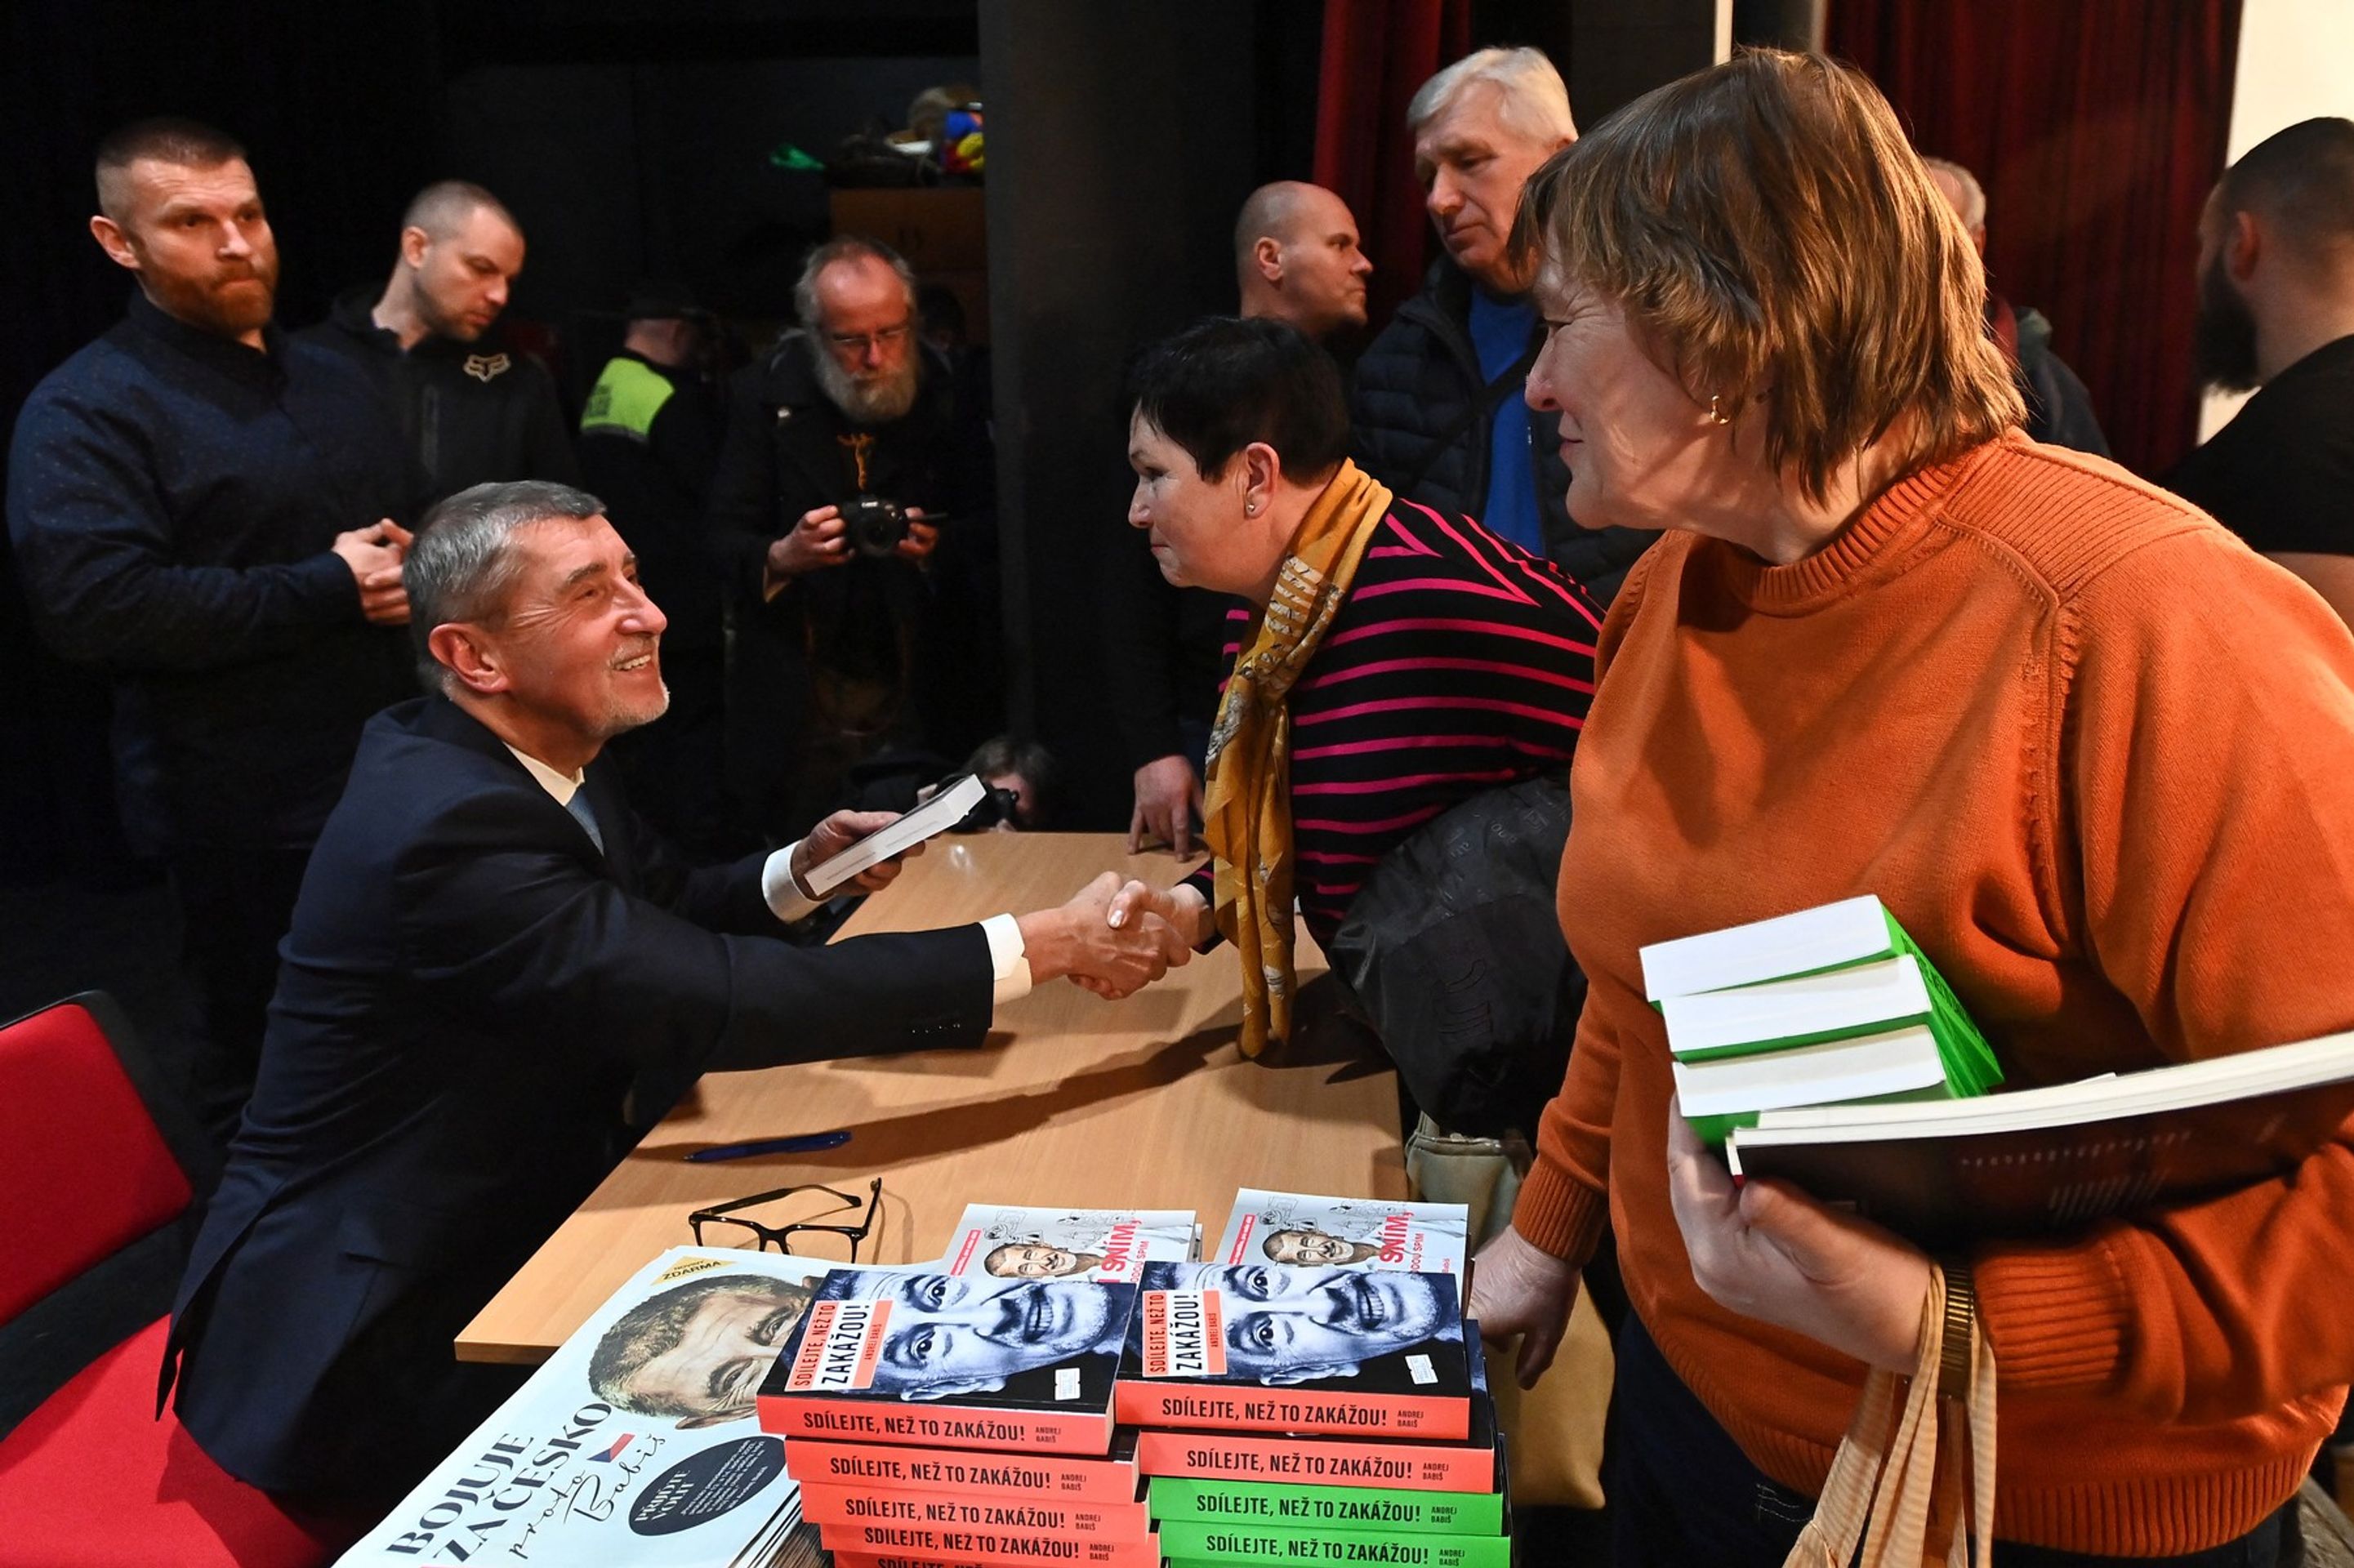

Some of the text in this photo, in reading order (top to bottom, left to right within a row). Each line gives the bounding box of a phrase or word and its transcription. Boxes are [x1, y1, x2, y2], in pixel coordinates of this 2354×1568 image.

[1101, 1218, 1142, 1272] SNÍM,
[1379, 1211, 1415, 1263] SNÍM,
[663, 1261, 721, 1280] ZDARMA
[794, 1305, 836, 1386] SDÍLEJTE, NEŽ TO
[821, 1305, 869, 1384] ZAKÁŽOU!
[1147, 1294, 1166, 1372] SDÍLEJTE, NEŽ TO
[1170, 1294, 1202, 1370] ZAKÁŽOU!
[804, 1411, 1024, 1441] SDÍLEJTE, NEŽ TO ZAKÁŽOU!
[1163, 1396, 1386, 1425] SDÍLEJTE, NEŽ TO ZAKÁŽOU!
[433, 1403, 612, 1562] ZA ČESKO
[564, 1433, 666, 1524] Babiš
[831, 1456, 1050, 1488] SDÍLEJTE, NEŽ TO ZAKÁŽOU!
[1188, 1449, 1411, 1478] SDÍLEJTE, NEŽ TO ZAKÁŽOU!
[386, 1433, 533, 1554] BOJUJE
[652, 1482, 694, 1520] VOLIT
[1197, 1493, 1420, 1521] SDÍLEJTE, NEŽ TO ZAKÁŽOU!
[846, 1498, 1063, 1528] SDÍLEJTE, NEŽ TO ZAKÁŽOU!
[977, 1536, 996, 1552] TO
[1001, 1538, 1078, 1557] ZAKÁŽOU!
[1207, 1534, 1428, 1564] SDÍLEJTE, NEŽ TO ZAKÁŽOU!
